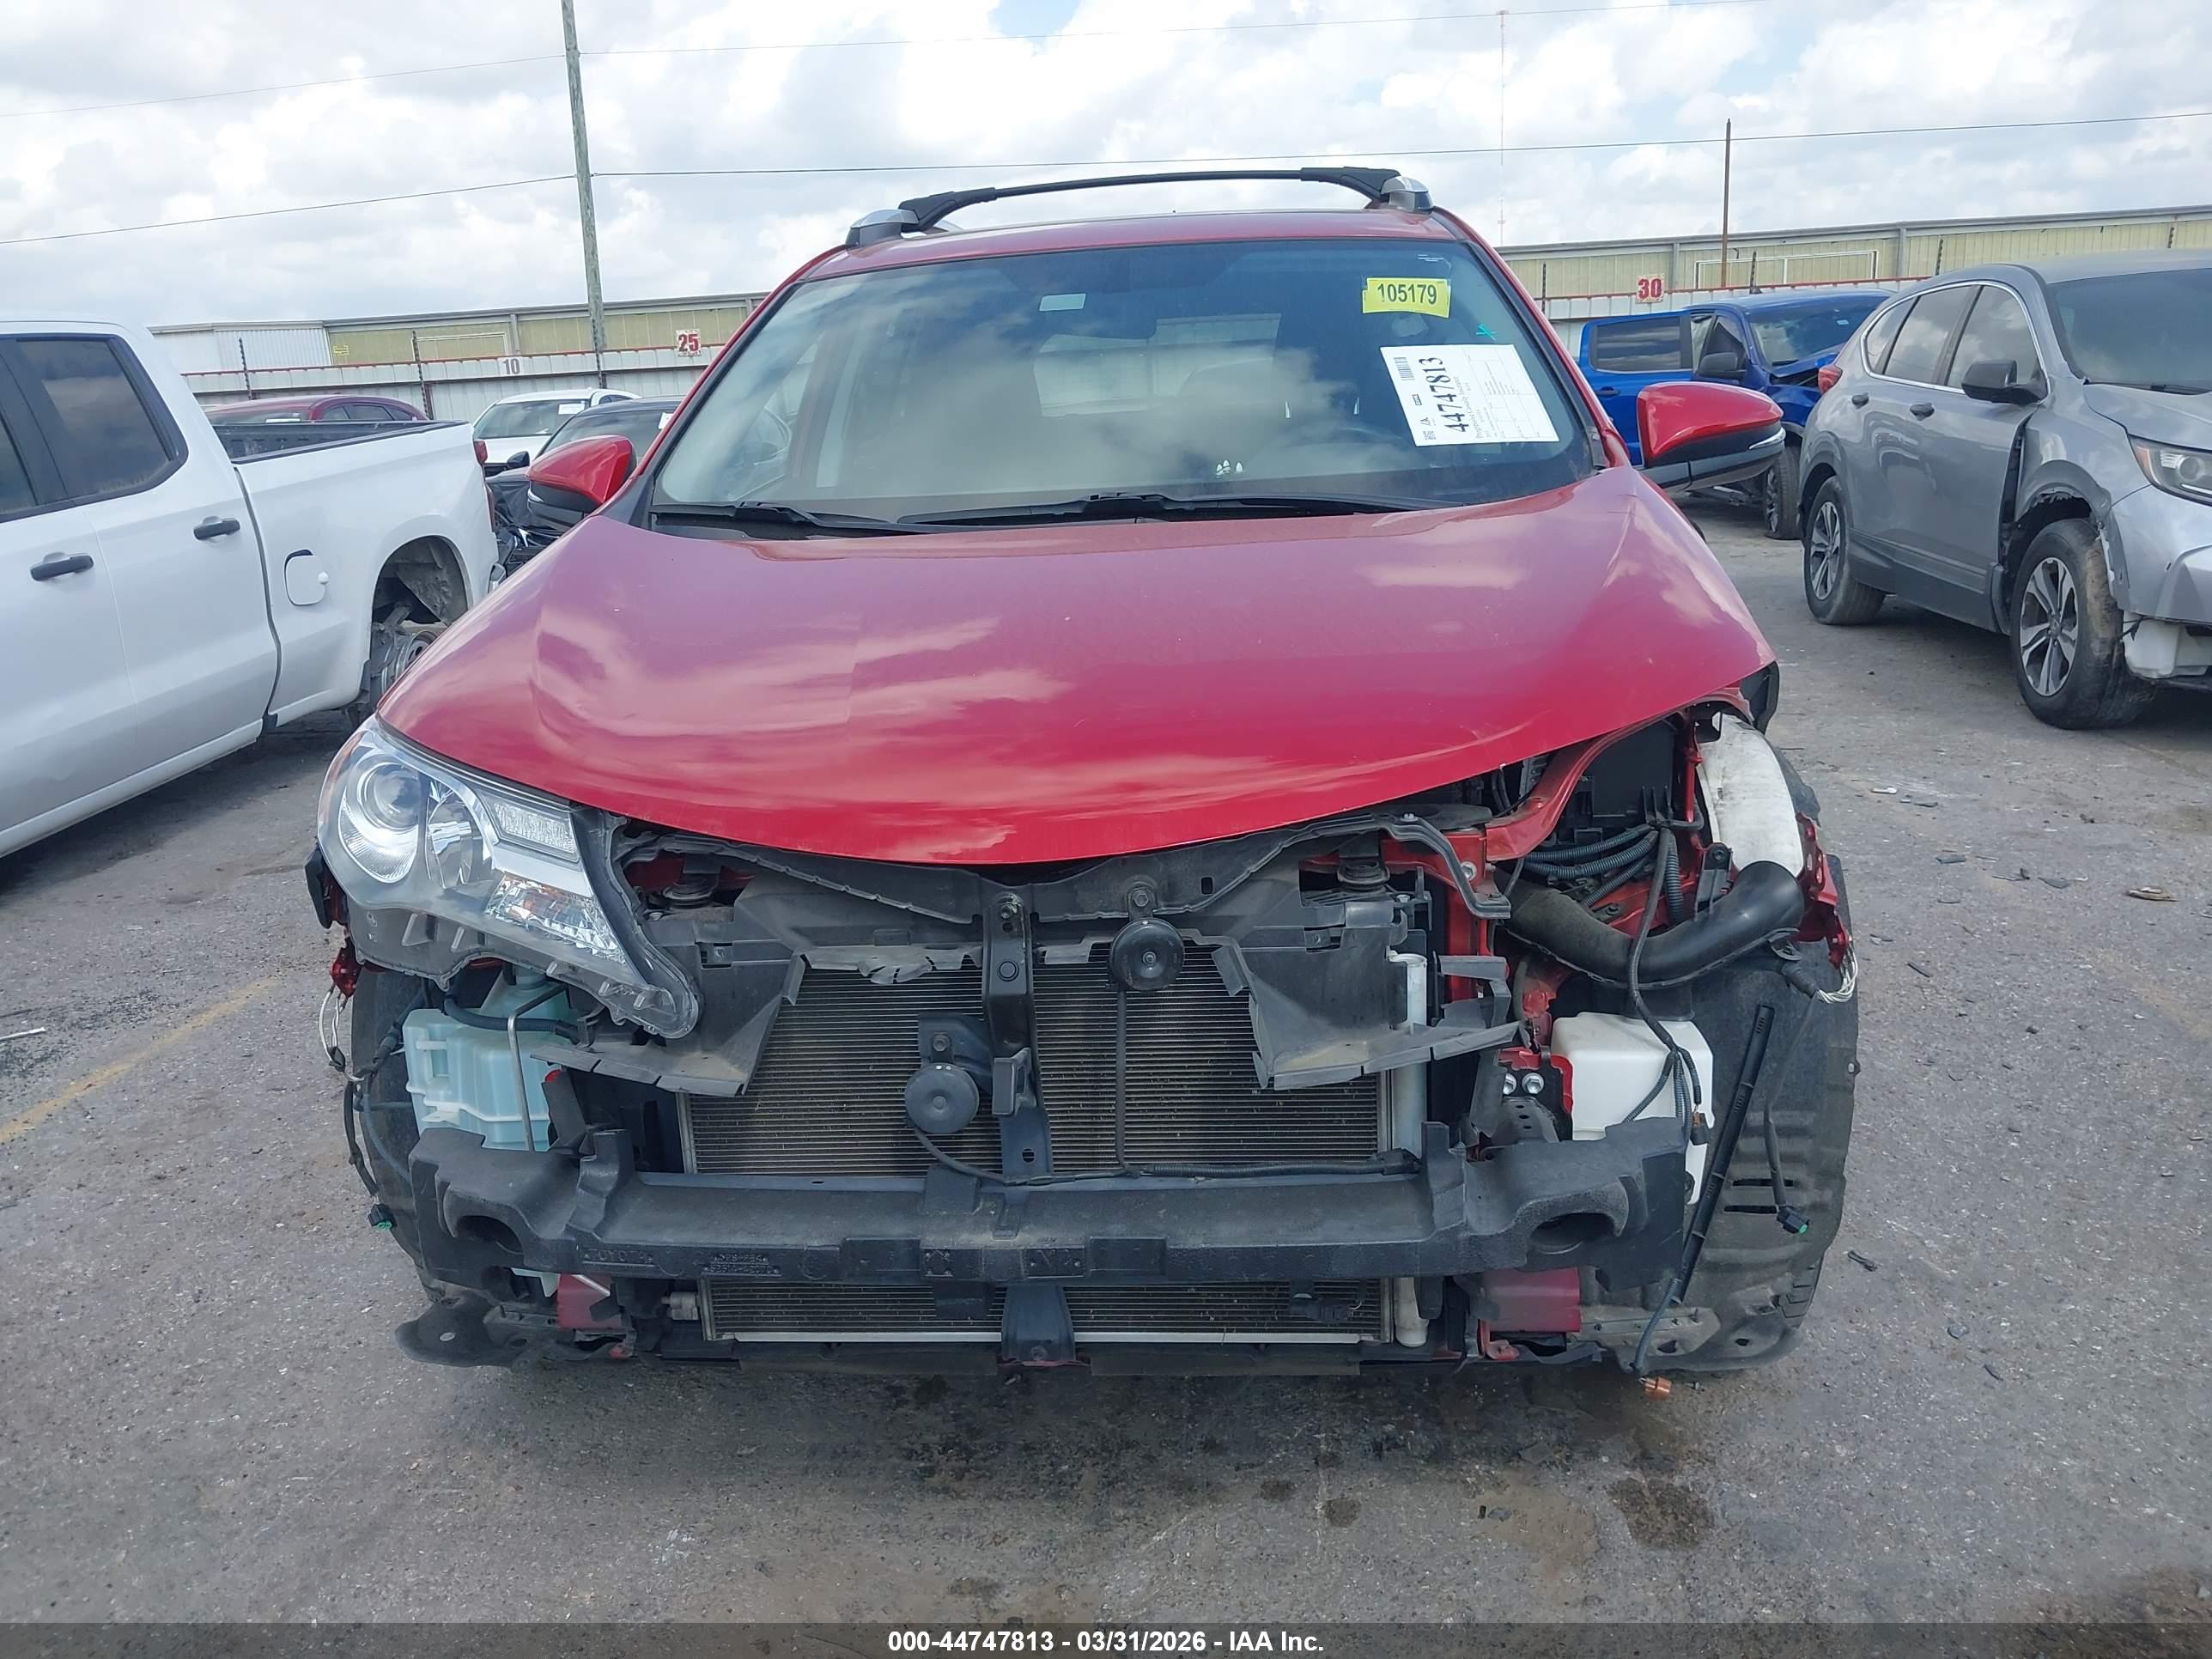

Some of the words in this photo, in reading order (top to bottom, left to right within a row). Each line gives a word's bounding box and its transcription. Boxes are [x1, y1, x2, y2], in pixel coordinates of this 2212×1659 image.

[1377, 284, 1437, 305] 105179
[1638, 278, 1662, 299] 30
[678, 333, 701, 353] 25
[502, 357, 520, 374] 10
[1419, 357, 1469, 432] 44747813
